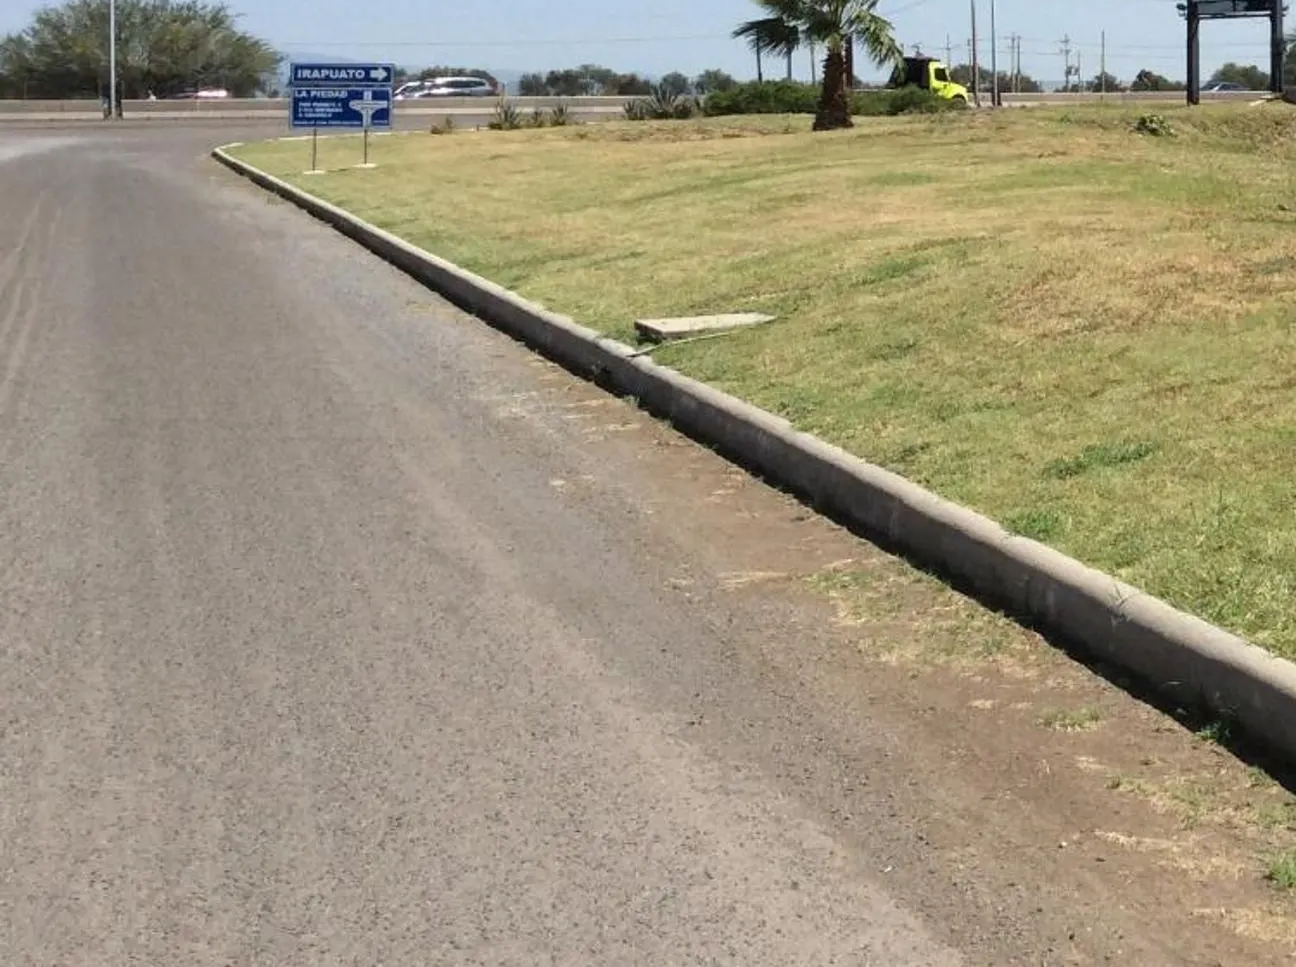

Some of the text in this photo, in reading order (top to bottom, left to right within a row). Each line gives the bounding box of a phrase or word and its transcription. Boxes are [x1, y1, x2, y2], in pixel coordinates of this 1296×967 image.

[297, 68, 366, 79] IRAPUATO
[294, 90, 349, 99] LA PIEDAD
